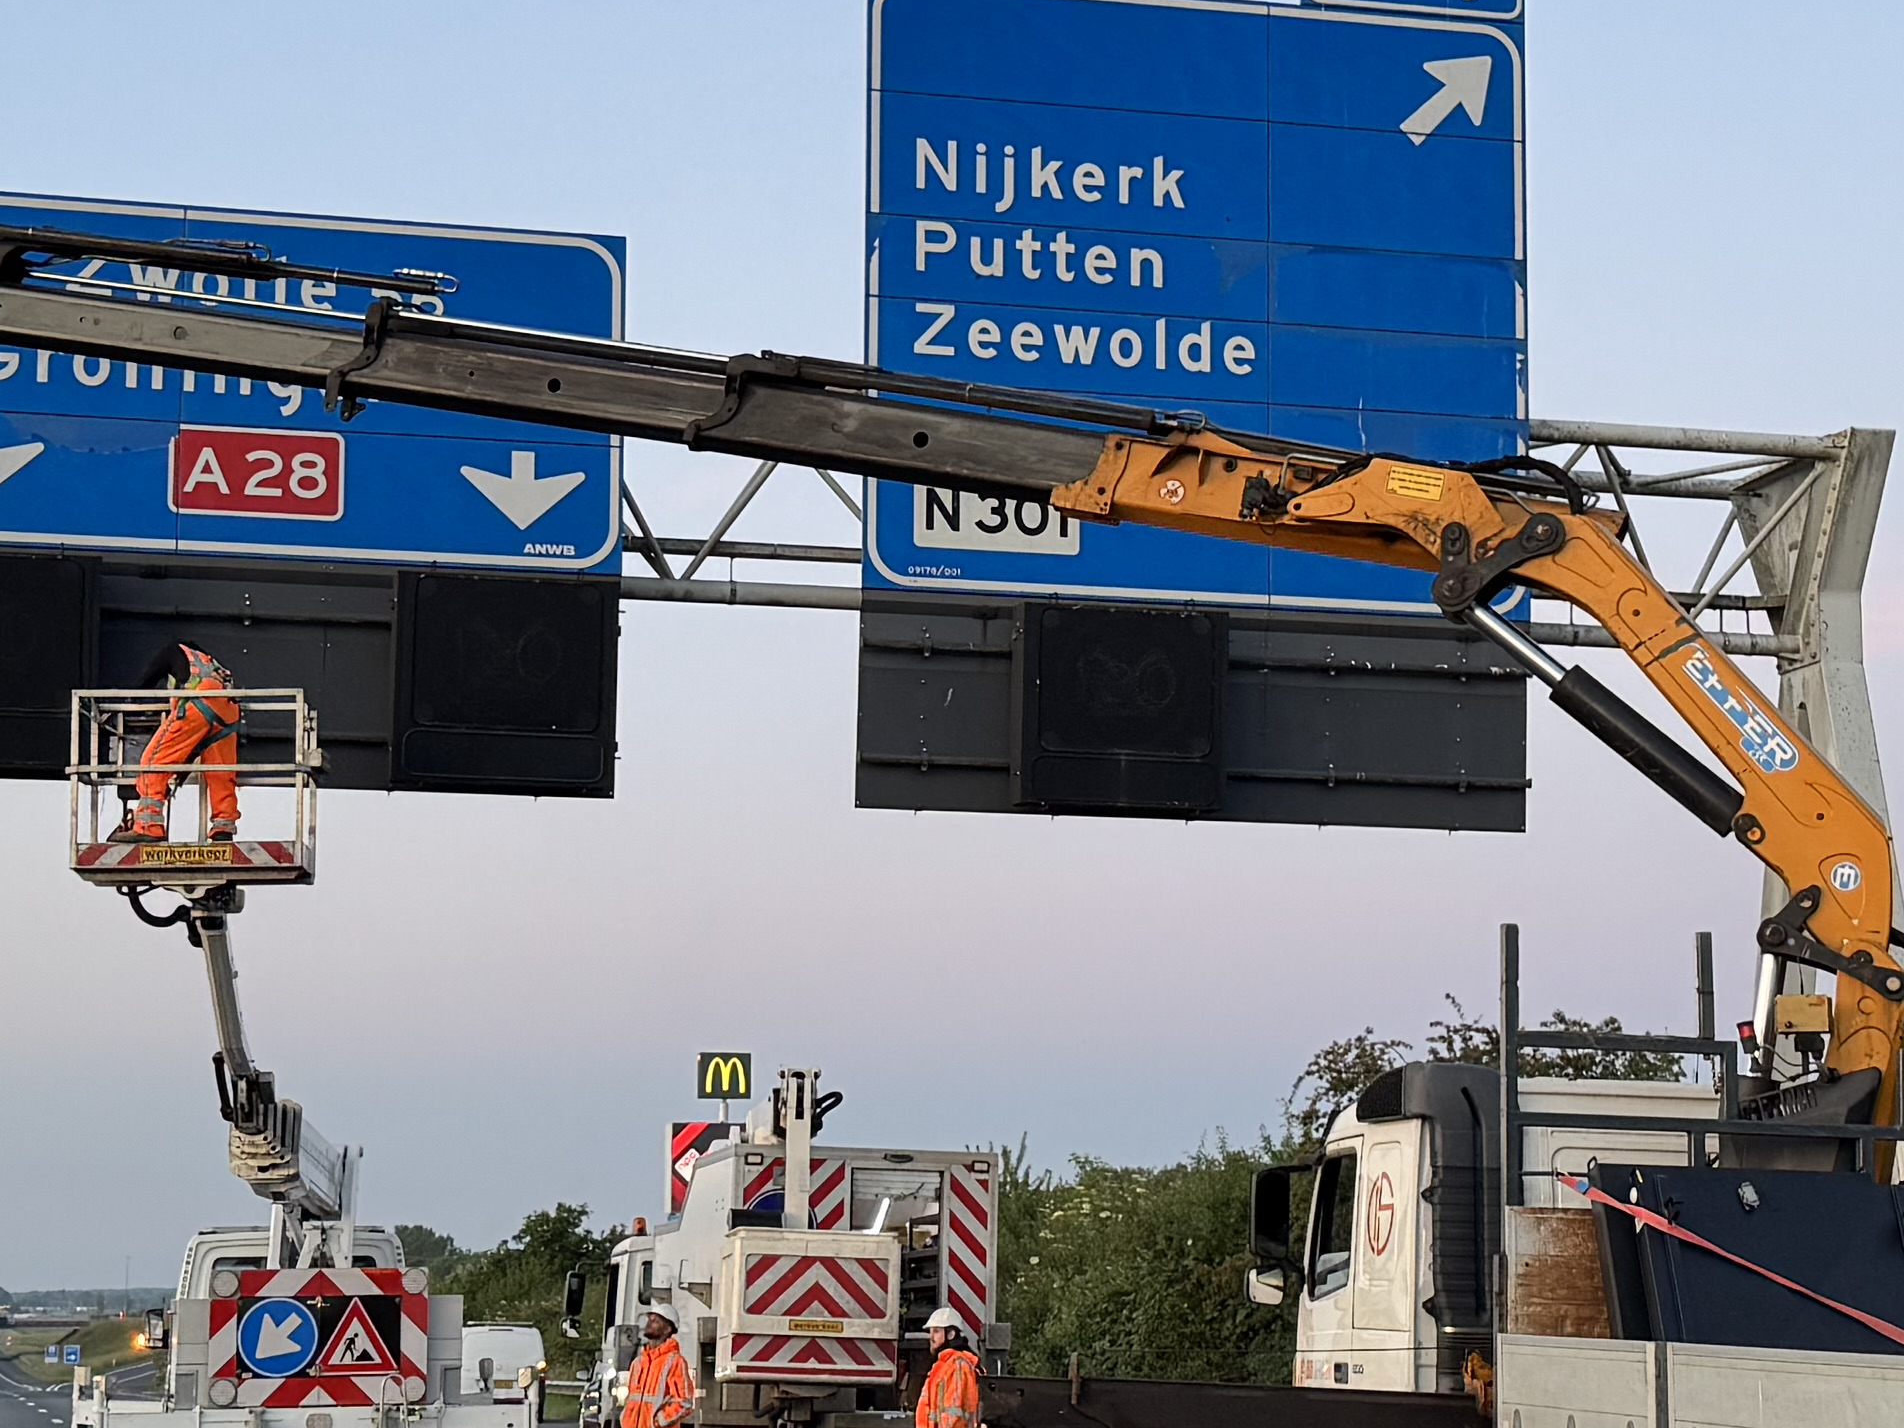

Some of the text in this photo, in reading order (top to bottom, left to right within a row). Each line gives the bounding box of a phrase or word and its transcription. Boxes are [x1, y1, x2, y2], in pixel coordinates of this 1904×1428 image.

[915, 137, 1185, 213] Nijkerk
[915, 219, 1164, 288] Putten
[913, 302, 1256, 375] Zeewolde
[182, 446, 329, 500] A 28
[523, 542, 576, 556] ANWB
